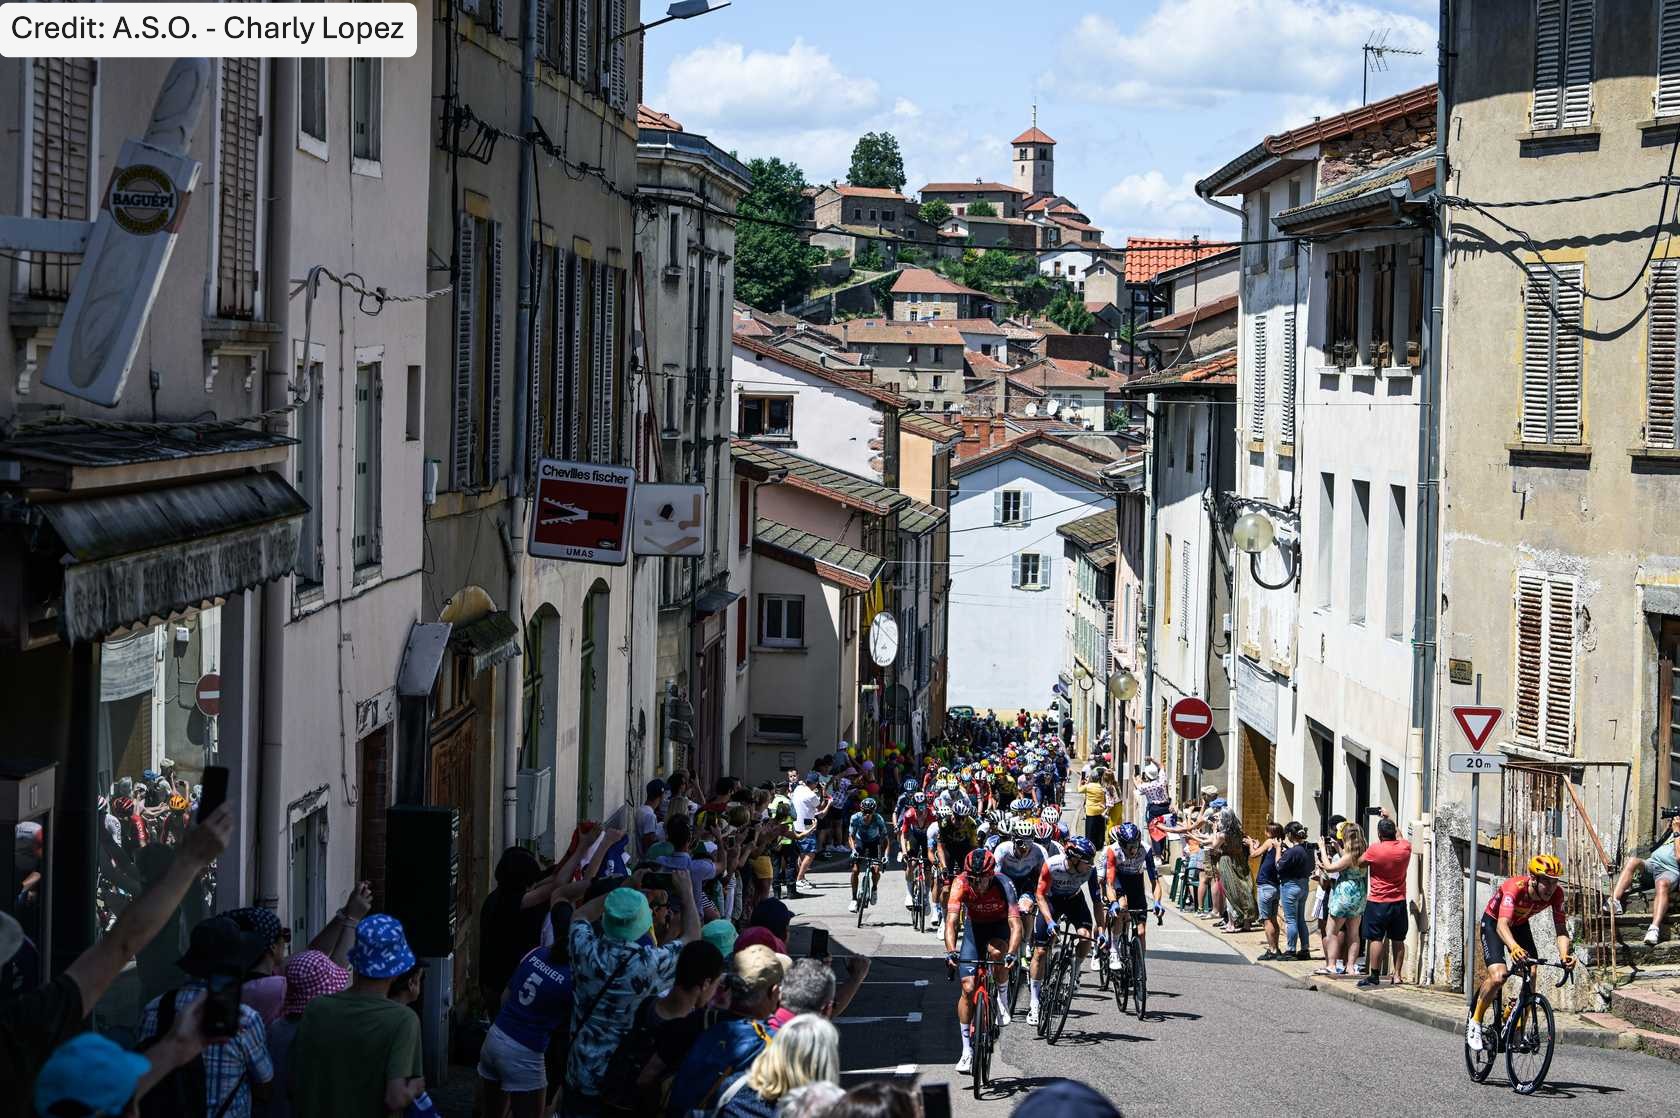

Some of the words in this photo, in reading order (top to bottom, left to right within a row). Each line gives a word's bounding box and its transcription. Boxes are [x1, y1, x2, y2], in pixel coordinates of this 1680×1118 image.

[592, 470, 630, 485] fischer
[566, 548, 594, 558] UMAS
[528, 955, 566, 985] PERRIER
[518, 972, 544, 1006] 5
